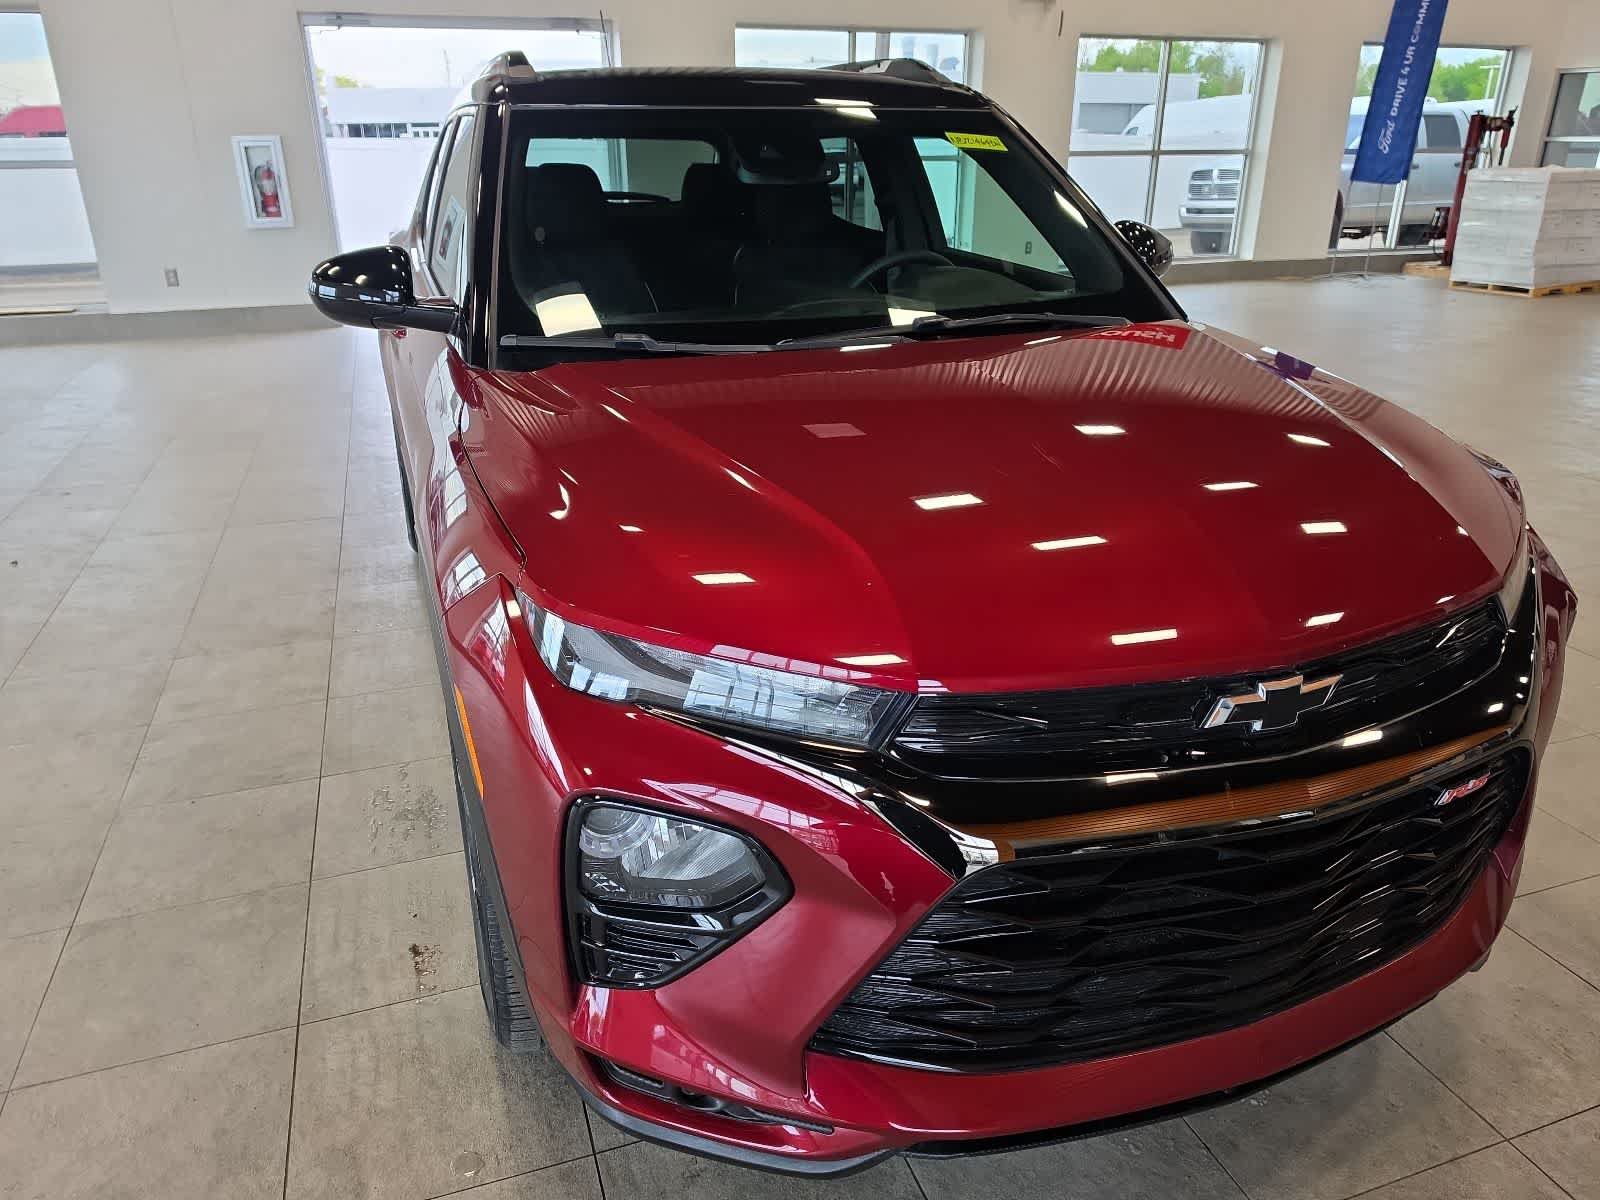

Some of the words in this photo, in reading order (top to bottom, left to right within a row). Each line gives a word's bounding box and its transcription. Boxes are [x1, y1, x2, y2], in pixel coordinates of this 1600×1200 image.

[1379, 120, 1396, 155] Ford
[1391, 77, 1408, 117] DRIVE
[1411, 0, 1430, 42] COMM
